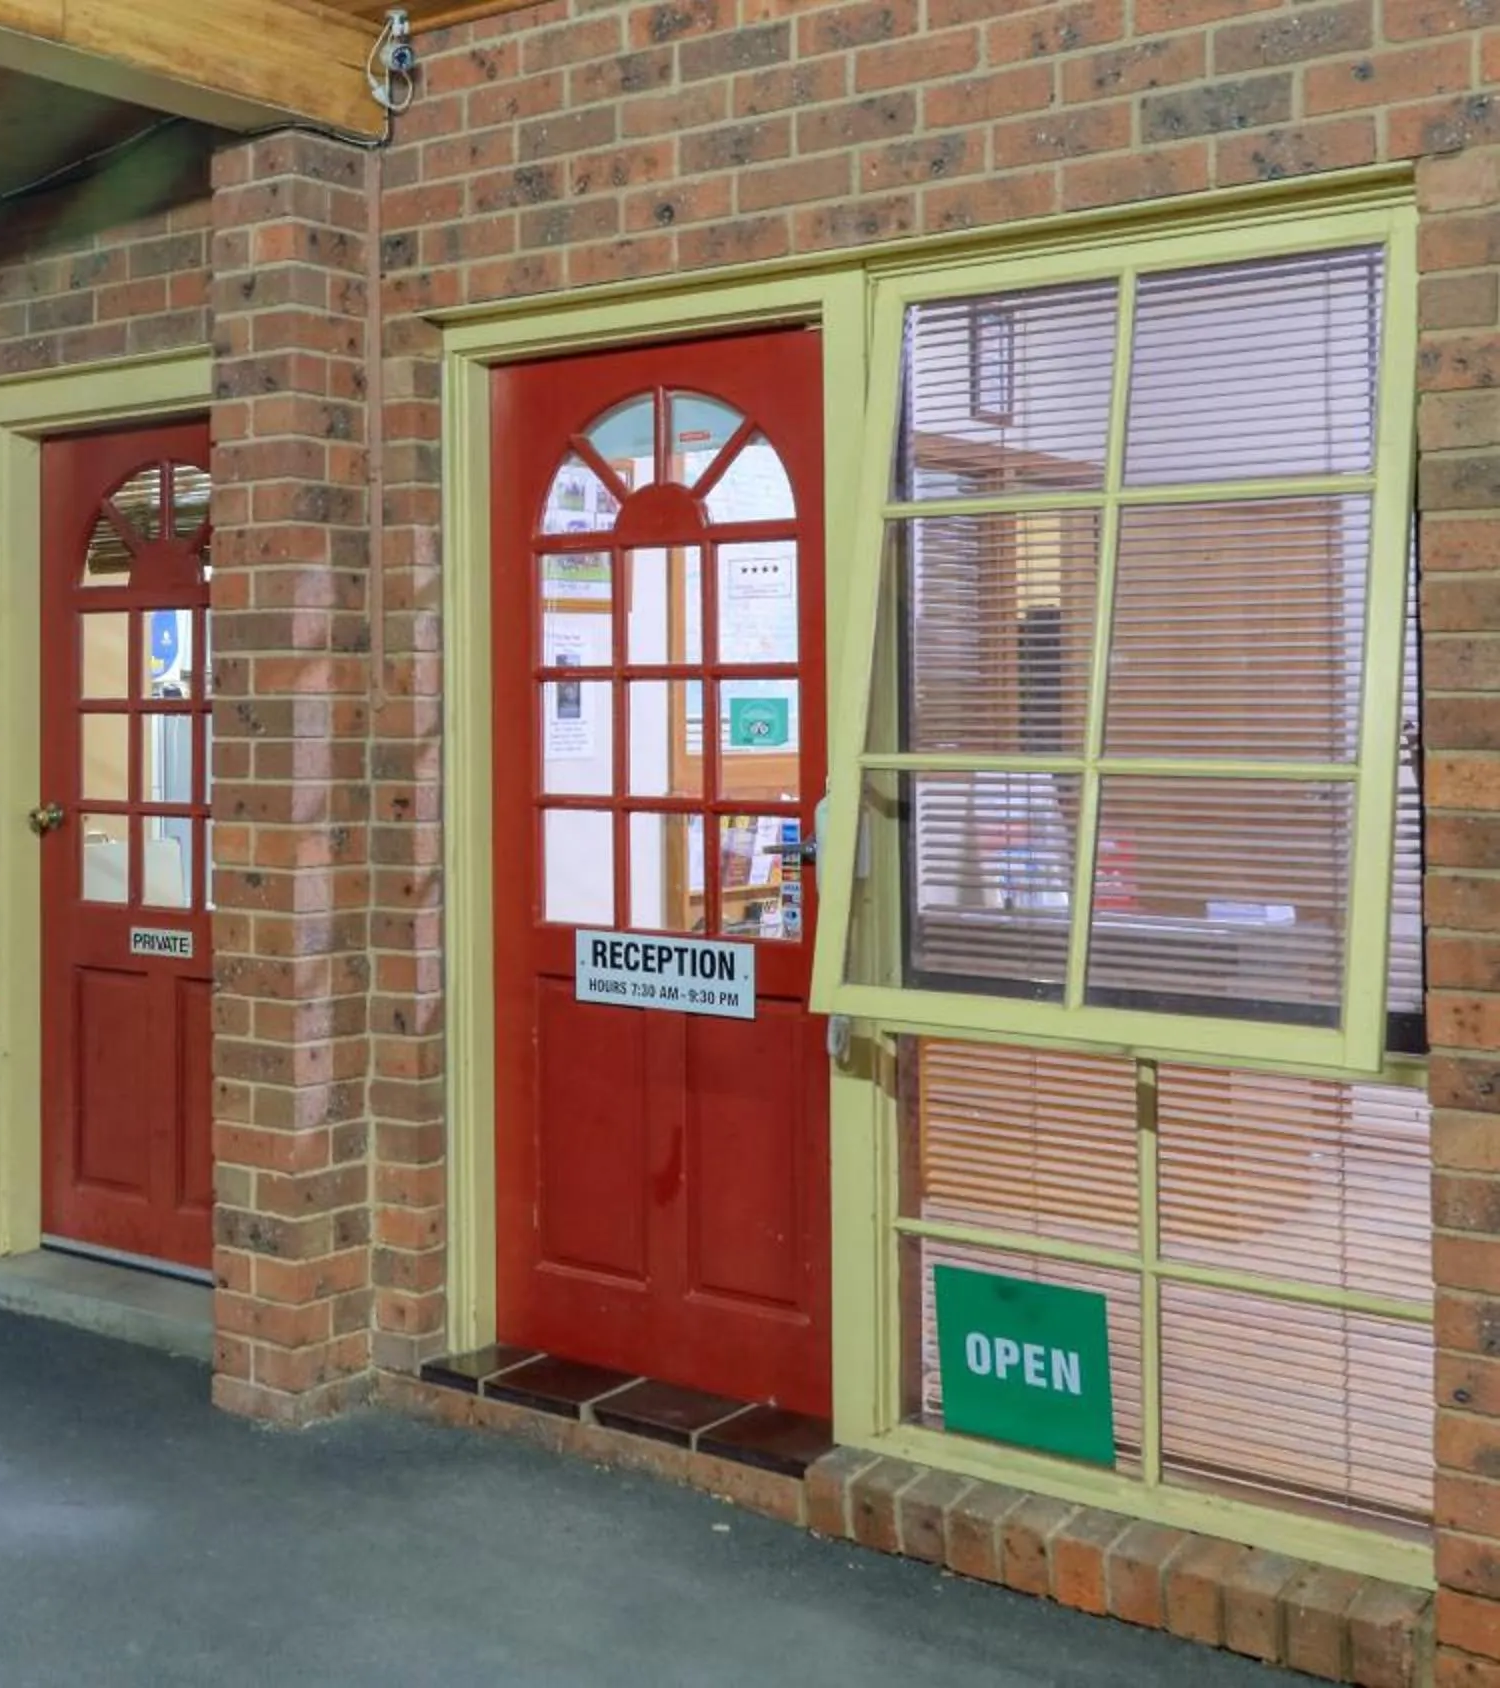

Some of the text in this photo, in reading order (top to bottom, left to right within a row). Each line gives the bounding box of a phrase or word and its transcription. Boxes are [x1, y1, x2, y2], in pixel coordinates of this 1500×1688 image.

[133, 932, 189, 953] PRIVATE
[591, 939, 736, 981] RECEPTION
[588, 977, 627, 995] HOURS
[631, 982, 656, 998] 7:30
[719, 991, 739, 1006] PM
[965, 1331, 1082, 1395] OPEN
